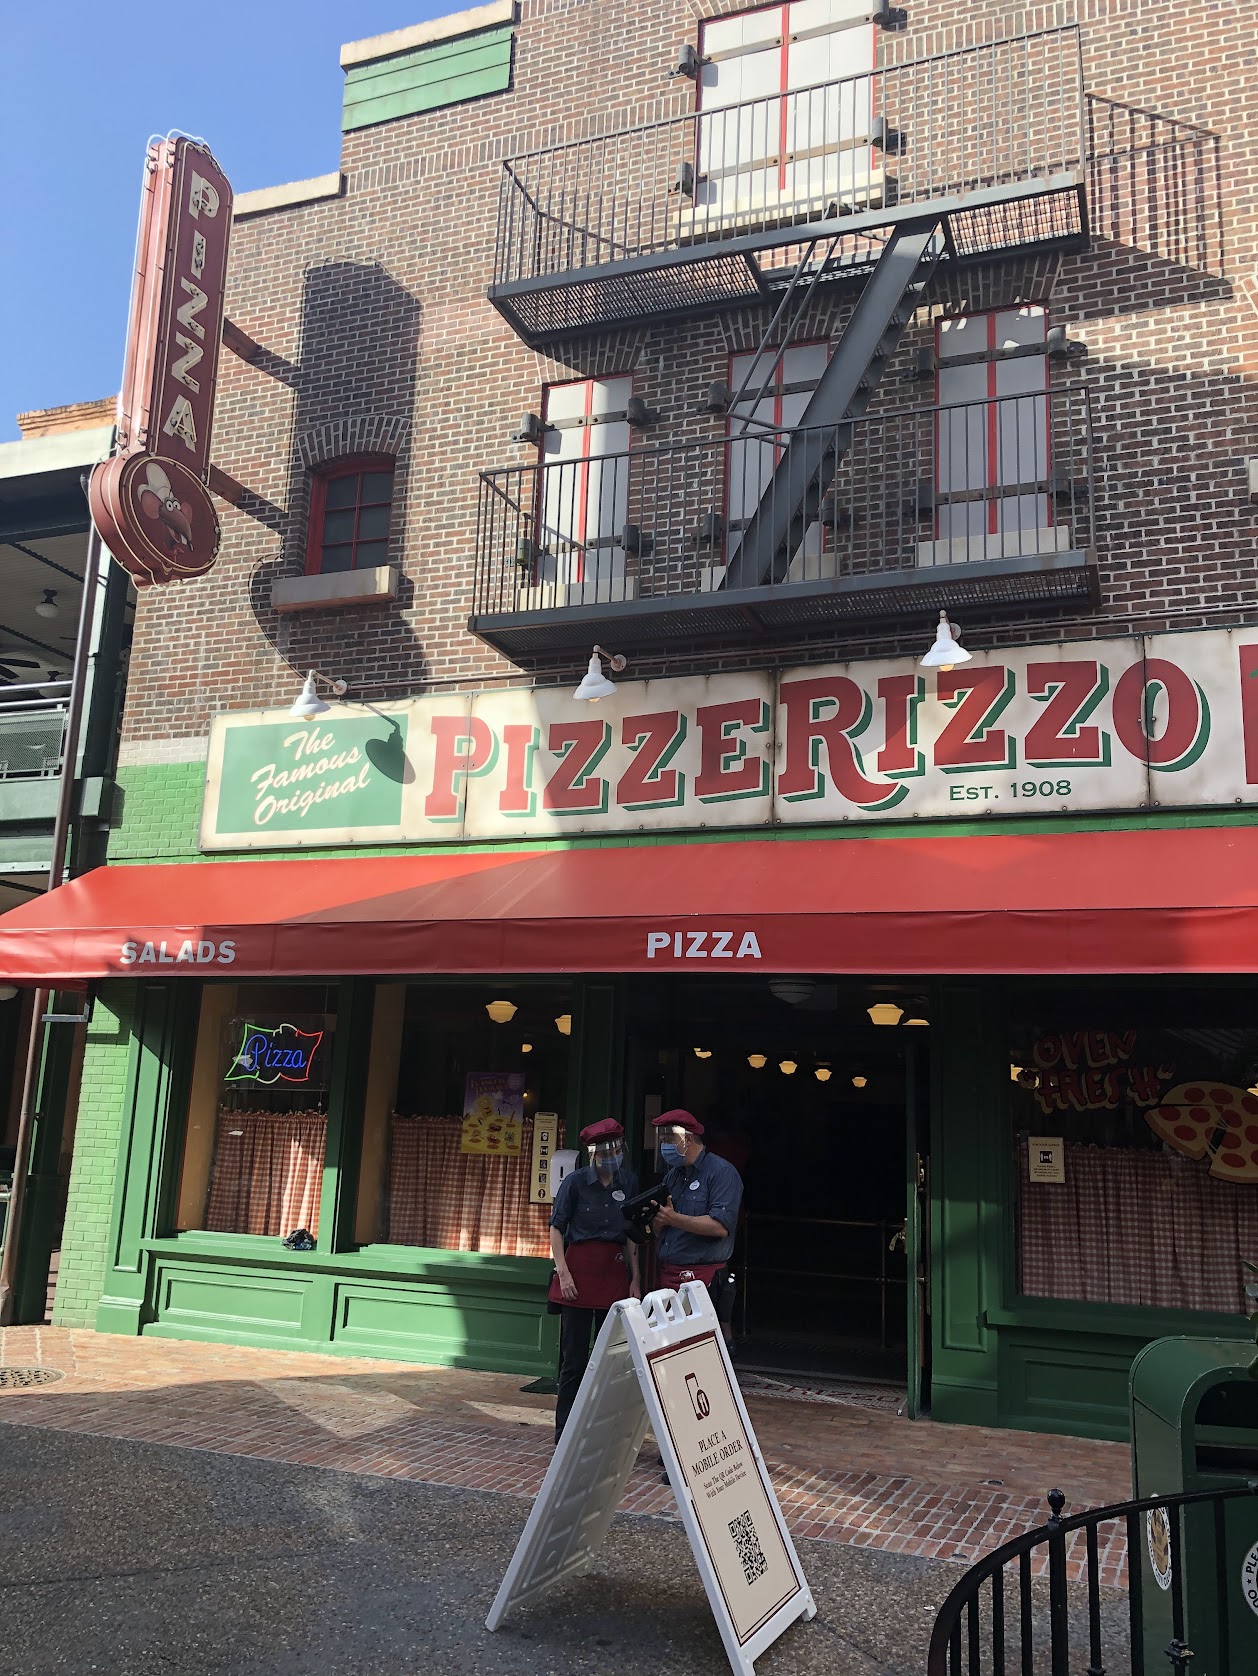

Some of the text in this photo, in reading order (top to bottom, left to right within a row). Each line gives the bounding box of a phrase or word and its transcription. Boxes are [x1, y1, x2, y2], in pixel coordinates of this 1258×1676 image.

[163, 170, 220, 453] PIZZA
[283, 727, 335, 760] The
[425, 658, 1210, 823] PIZZERIZZO
[250, 747, 362, 800] Famous
[1010, 780, 1072, 798] 1908
[253, 762, 371, 825] Original
[119, 940, 236, 964] SALADS
[647, 931, 762, 958] PIZZA
[244, 1034, 307, 1071] Pizza
[1033, 1028, 1137, 1070] OVEN
[691, 1439, 743, 1477] MOBILE ORDER
[698, 1429, 727, 1452] PLACE A
[1246, 1548, 1258, 1574] PLE
